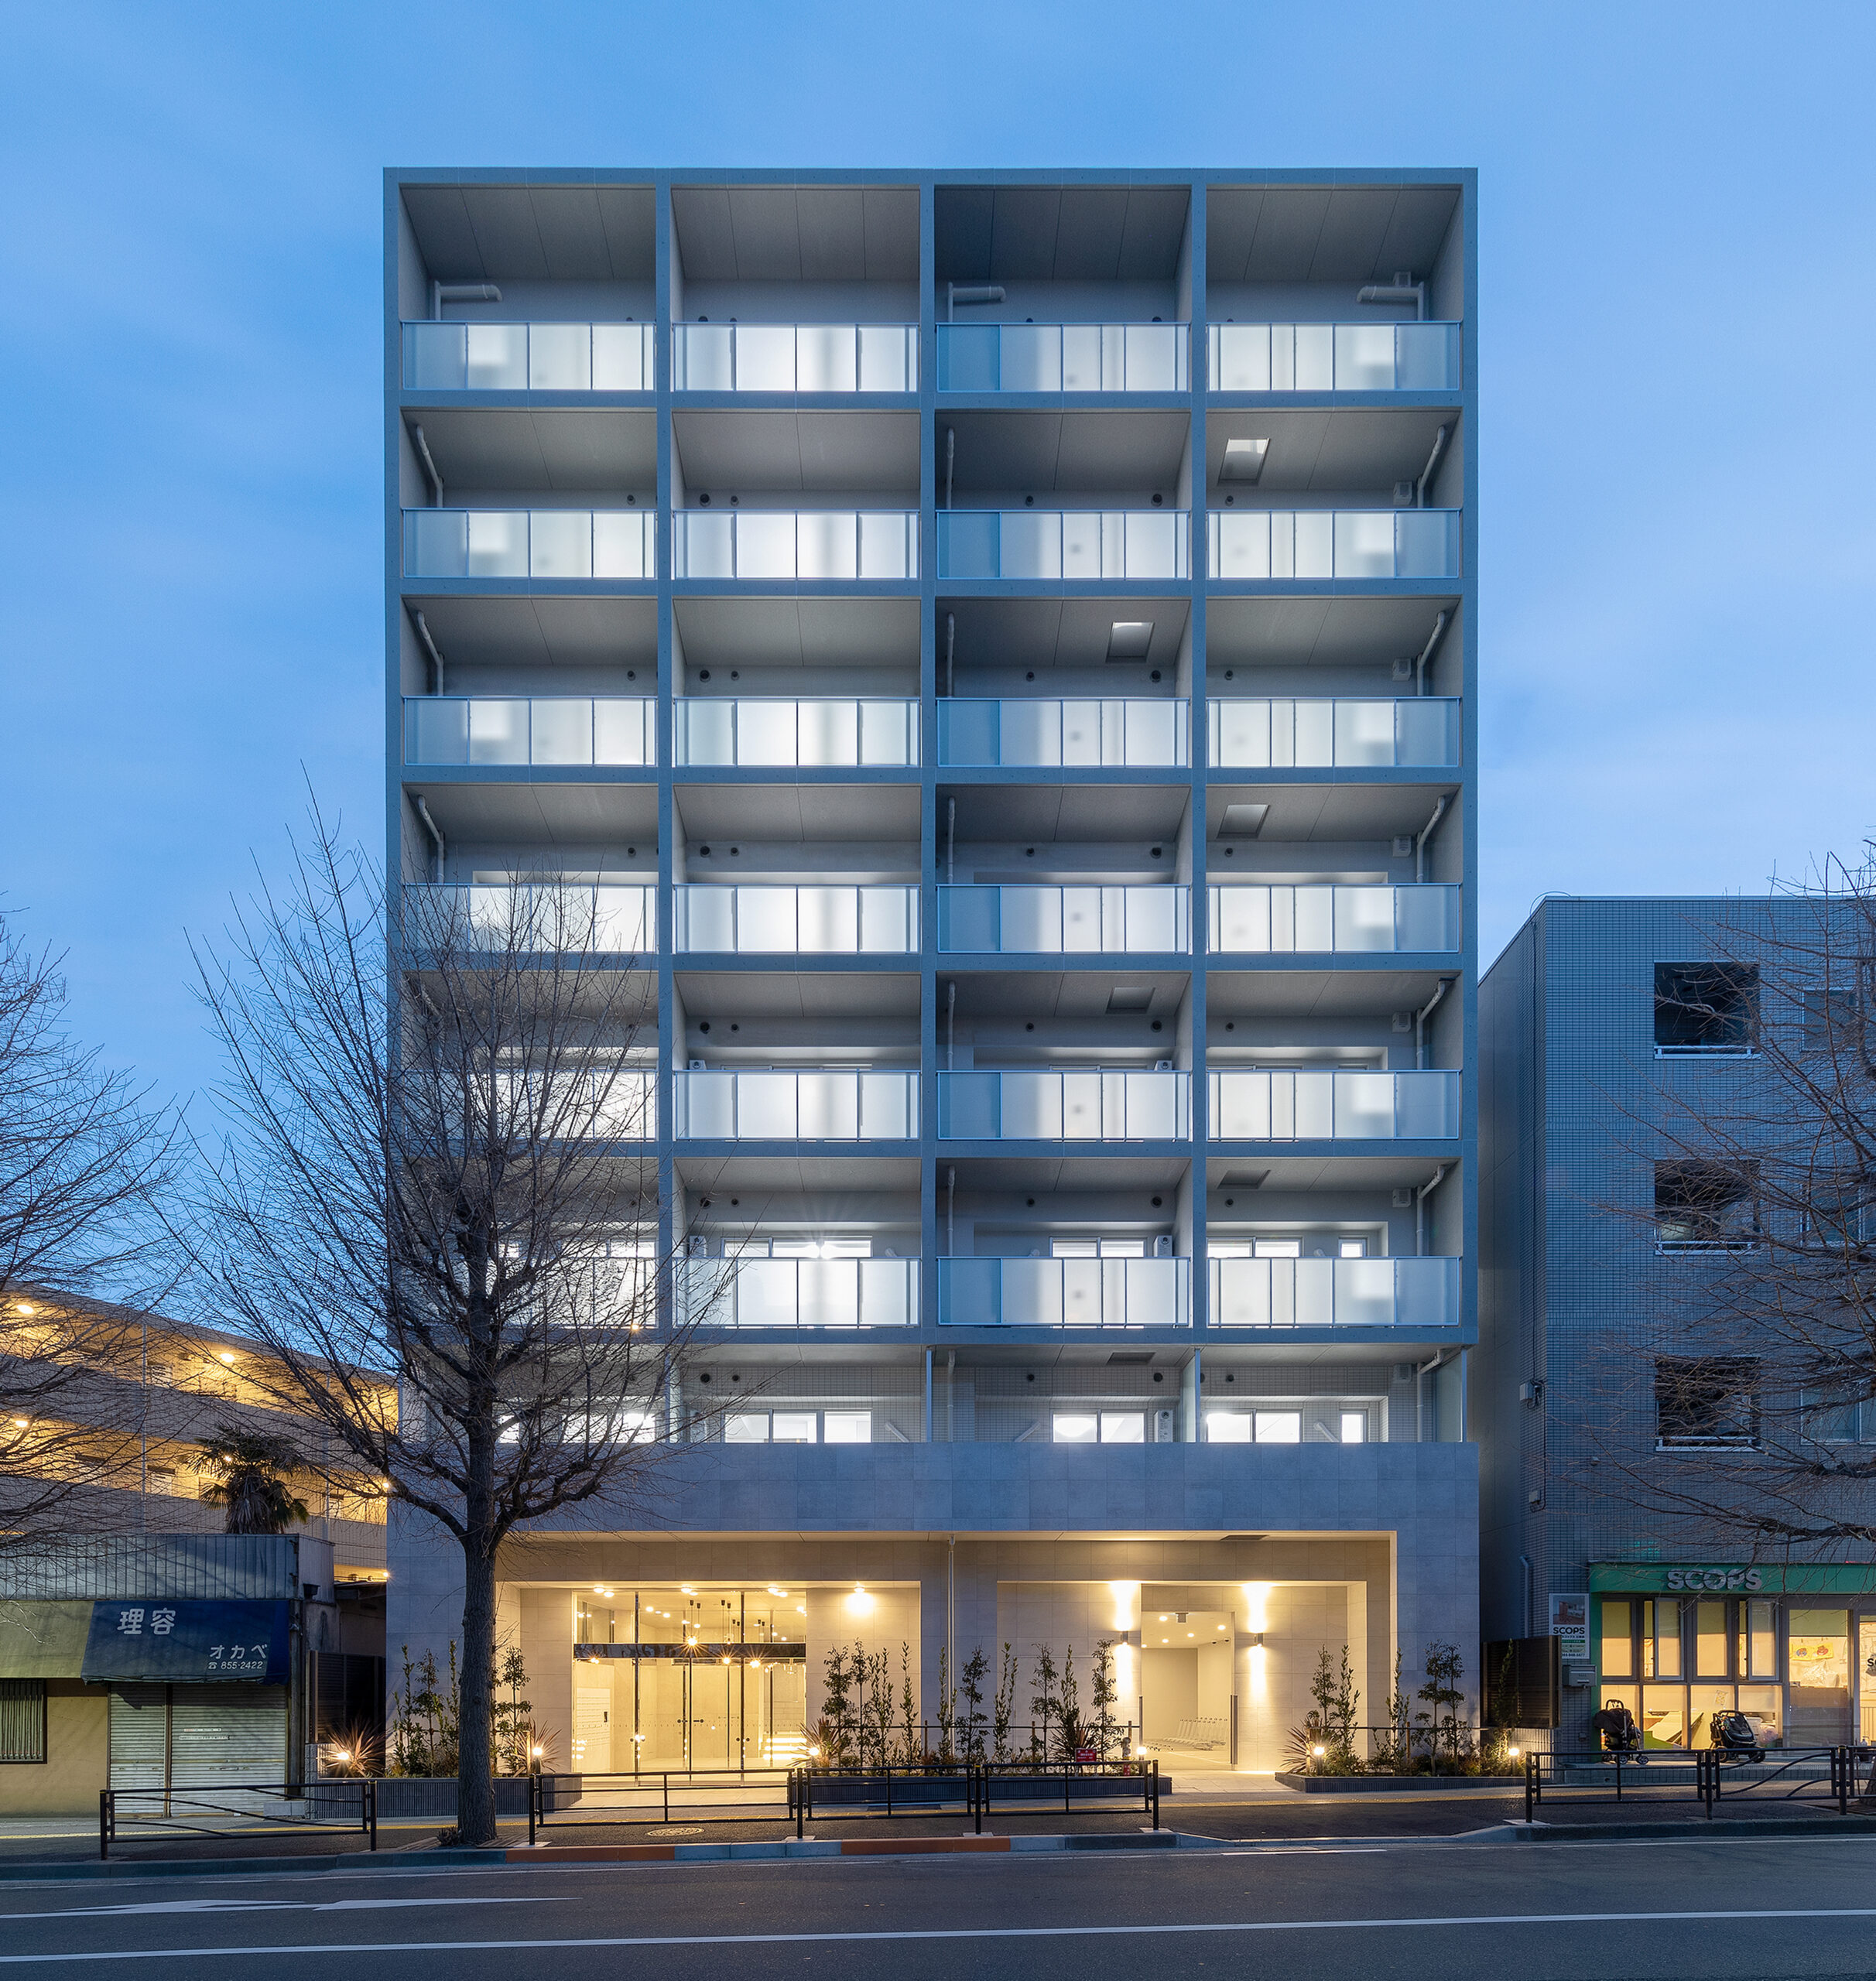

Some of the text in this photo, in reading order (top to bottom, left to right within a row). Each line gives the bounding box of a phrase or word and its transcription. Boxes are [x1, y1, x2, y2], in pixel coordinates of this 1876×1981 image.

[1667, 1569, 1762, 1590] SCOPS
[117, 1607, 176, 1634] 理容
[210, 1644, 268, 1659] オカベ
[221, 1661, 263, 1669] 855-2422
[1867, 1658, 1876, 1667] S
